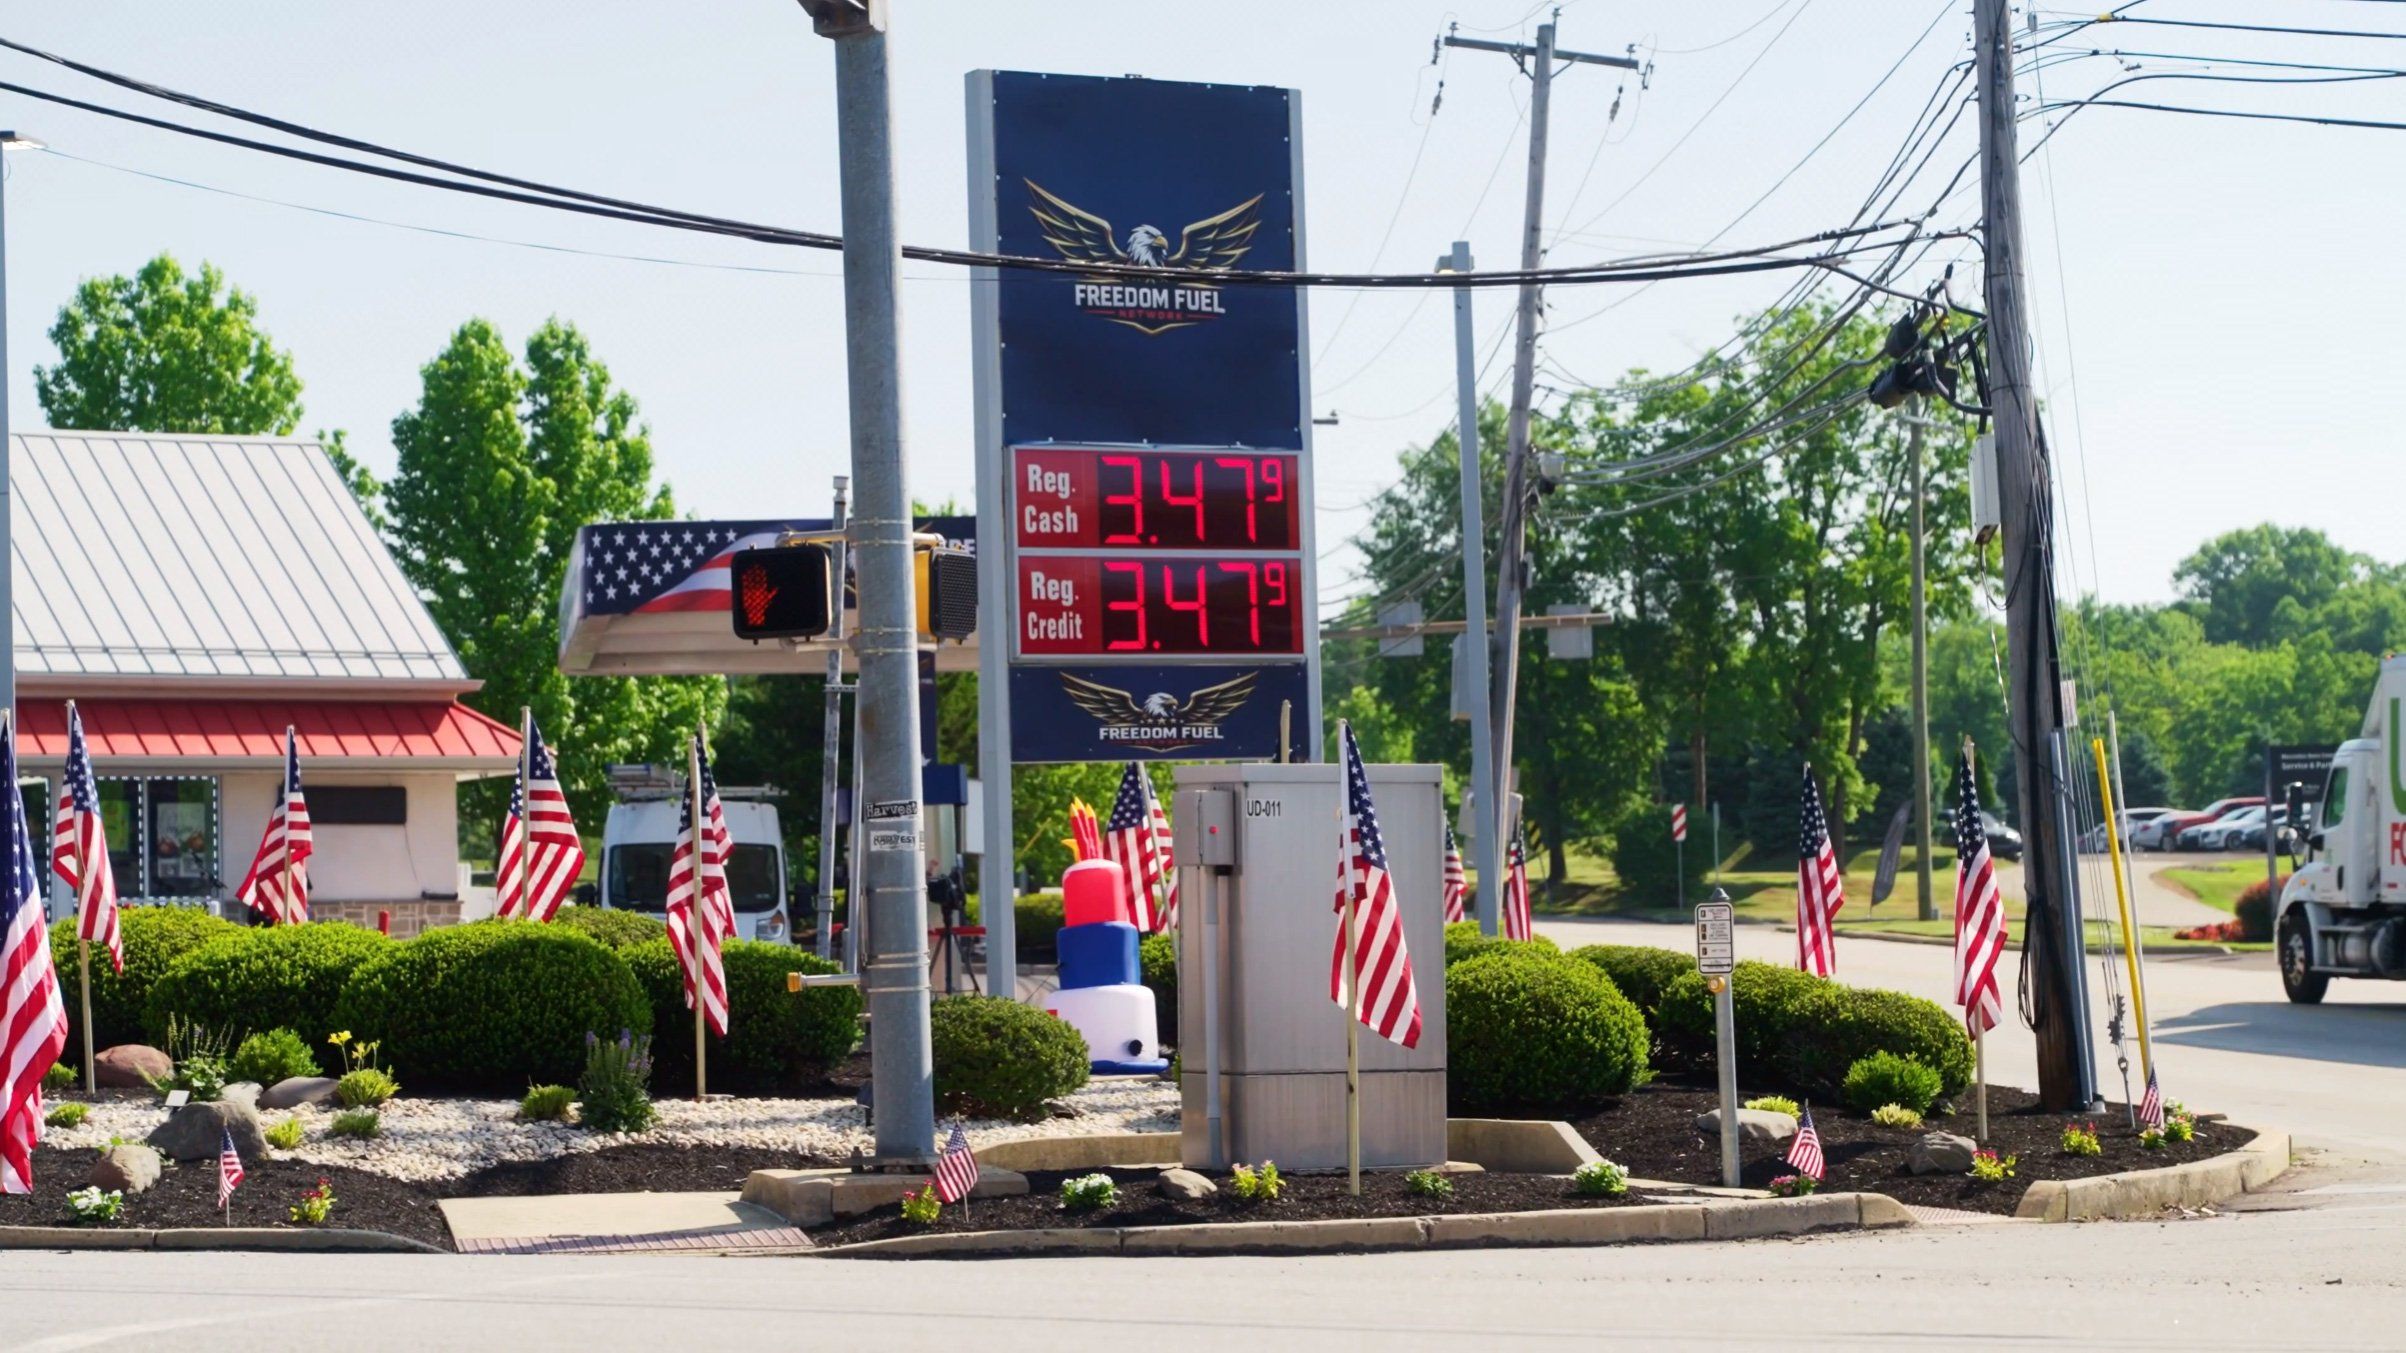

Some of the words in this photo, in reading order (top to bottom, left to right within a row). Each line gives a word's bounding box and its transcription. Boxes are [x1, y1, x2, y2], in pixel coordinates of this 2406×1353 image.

[1075, 284, 1169, 309] FREEDOM
[1174, 289, 1226, 314] FUEL
[1117, 309, 1182, 320] NETWORK
[1027, 463, 1076, 499] Reg.
[1024, 505, 1079, 534] Cash
[1031, 571, 1080, 606] Reg.
[1027, 611, 1083, 640] Credit
[1099, 727, 1177, 740] FREEDOM
[1181, 726, 1224, 739] FUEL
[1247, 800, 1281, 816] UD-011
